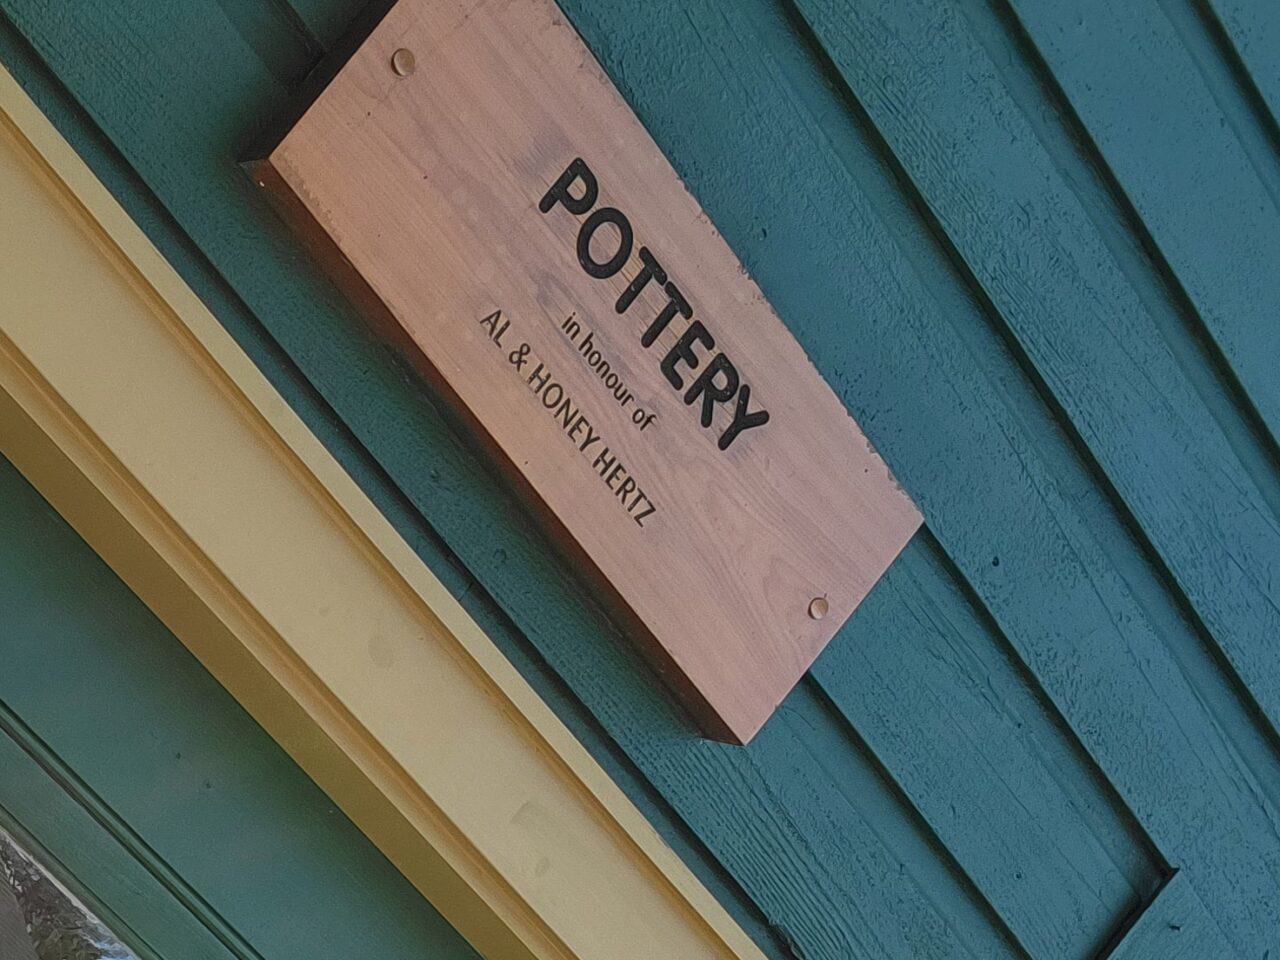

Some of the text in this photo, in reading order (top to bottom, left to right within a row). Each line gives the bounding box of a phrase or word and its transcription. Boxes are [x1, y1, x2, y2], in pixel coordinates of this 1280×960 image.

[538, 157, 770, 451] POTTERY
[561, 311, 657, 432] in honour of
[479, 309, 657, 528] AL & HONEY HERTZ
